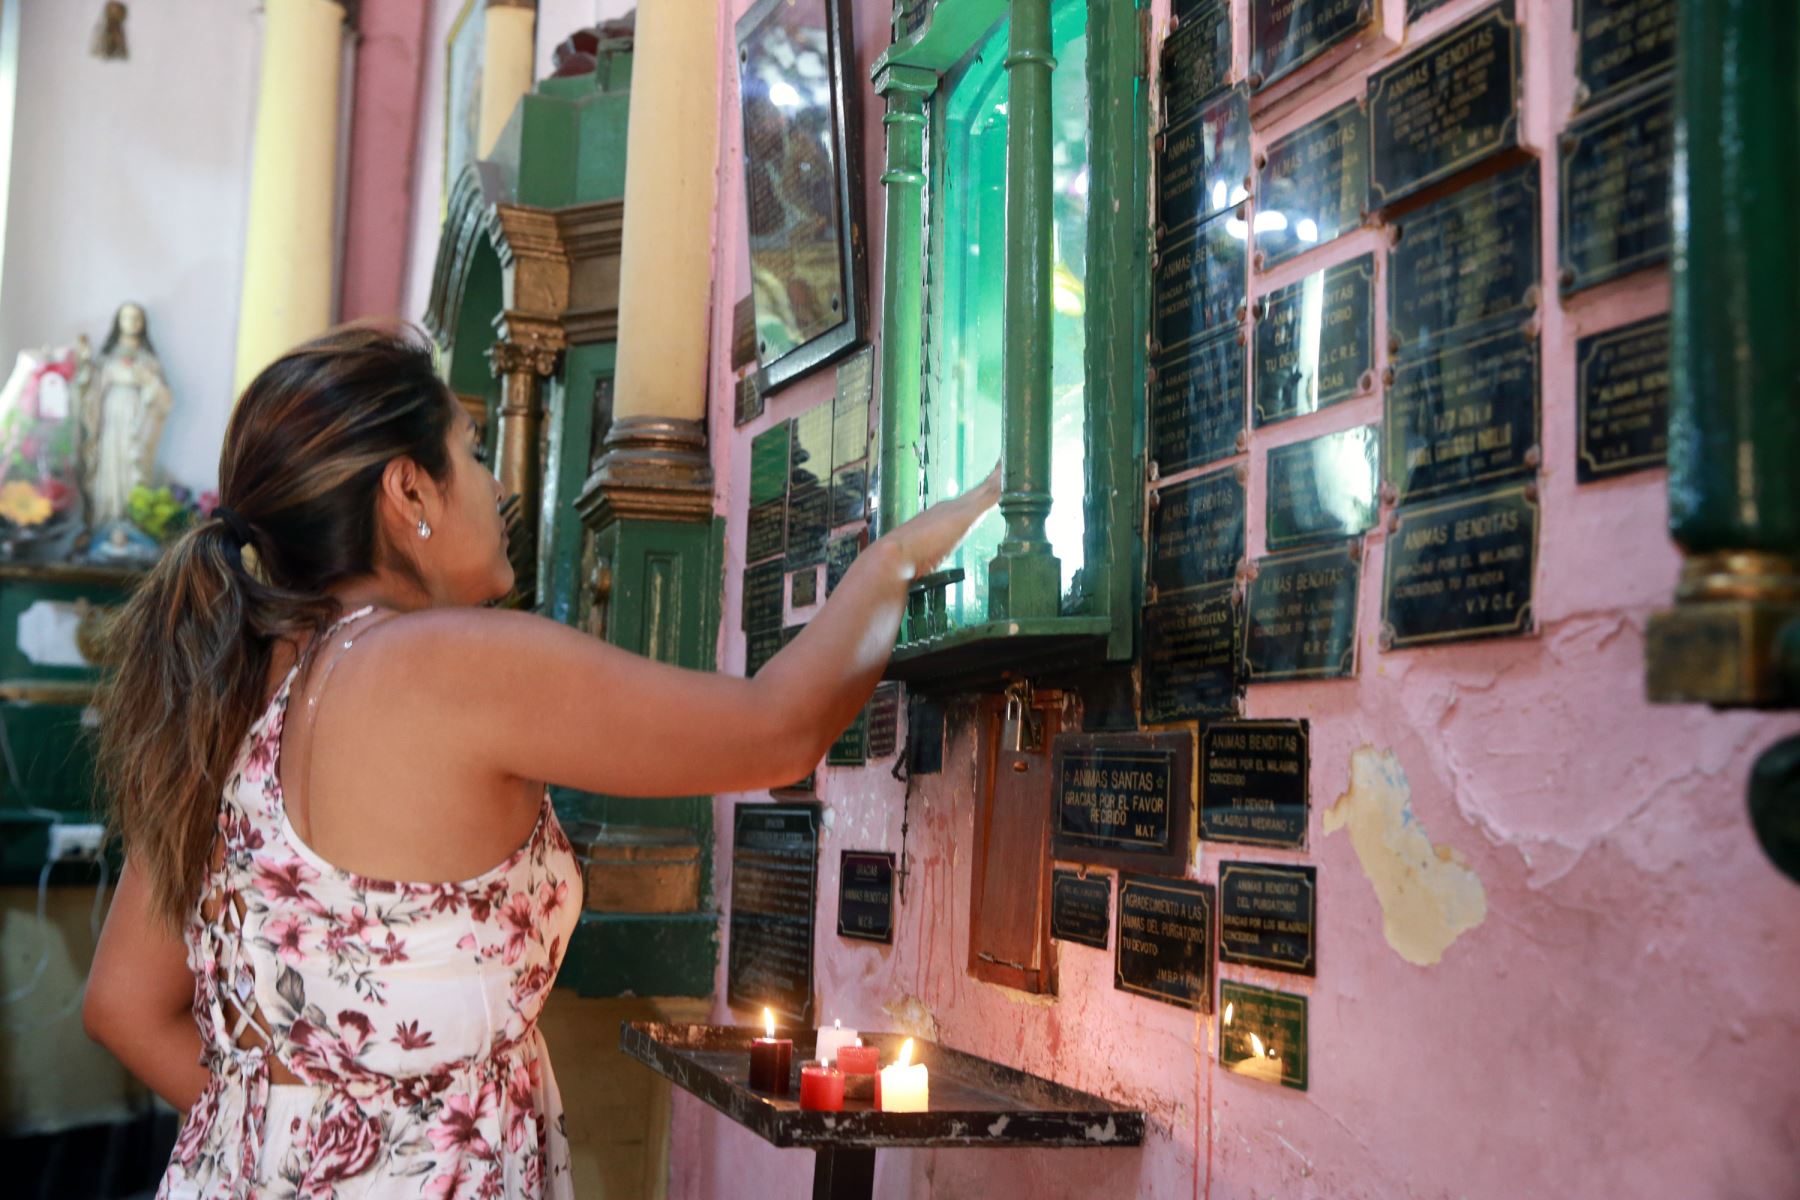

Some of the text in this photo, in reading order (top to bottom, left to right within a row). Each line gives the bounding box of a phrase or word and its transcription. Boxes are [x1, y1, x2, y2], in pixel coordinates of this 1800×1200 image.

[1193, 488, 1233, 513] BENDITAS
[1403, 510, 1518, 551] ANIMAS BENDITAS
[1438, 555, 1457, 571] POR
[1460, 553, 1472, 568] EL
[1261, 567, 1344, 593] ALMAS BENDITAS
[1212, 734, 1297, 753] ANIMAS BENDITAS
[1239, 758, 1254, 771] POR
[1256, 759, 1265, 771] EL
[1073, 769, 1153, 792] ANIMAS SANTAS
[1065, 791, 1164, 813] GRACIAS POR EL FAVOR
[1232, 797, 1276, 813] TU DEVOTA
[1090, 808, 1127, 826] RECIBIDO
[1236, 880, 1299, 896] ANIMAS BENDITAS
[1125, 893, 1202, 921] AGRADECIMIENTO A LAS
[1236, 896, 1297, 913] DEL PURGATORIO
[1122, 914, 1204, 944] ANIMAS DEL PURGATORIO
[1249, 917, 1261, 929] POR
[1122, 936, 1159, 957] TU DEVOTO
